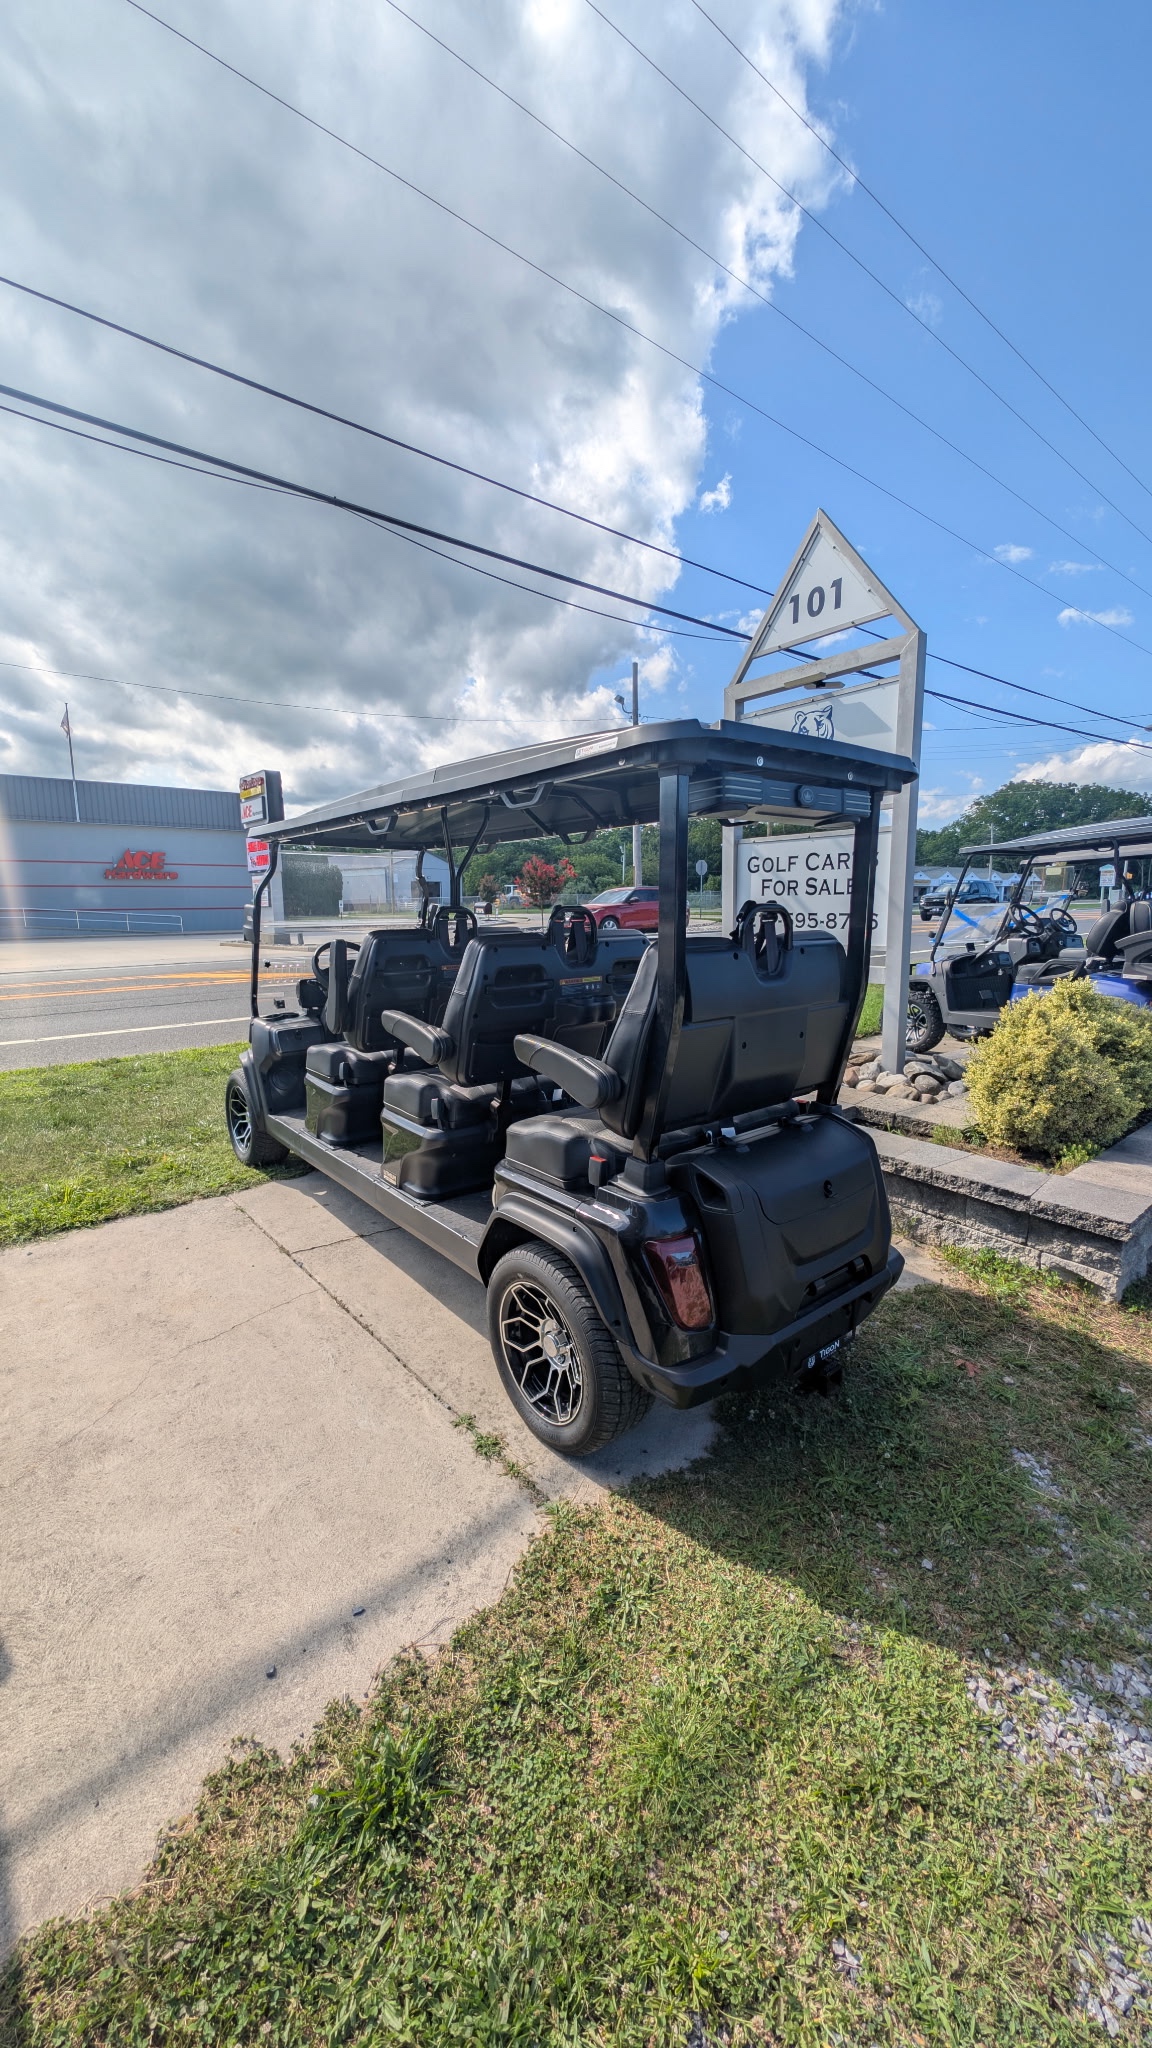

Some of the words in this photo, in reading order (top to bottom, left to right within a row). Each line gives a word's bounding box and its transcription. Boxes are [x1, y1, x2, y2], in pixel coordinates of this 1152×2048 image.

[788, 577, 843, 624] 101
[116, 849, 165, 869] ACE
[747, 856, 798, 873] GOLF
[805, 852, 878, 871] CAR
[104, 868, 178, 879] Hardware
[761, 879, 798, 896] FOR
[819, 1339, 840, 1358] TIGON
